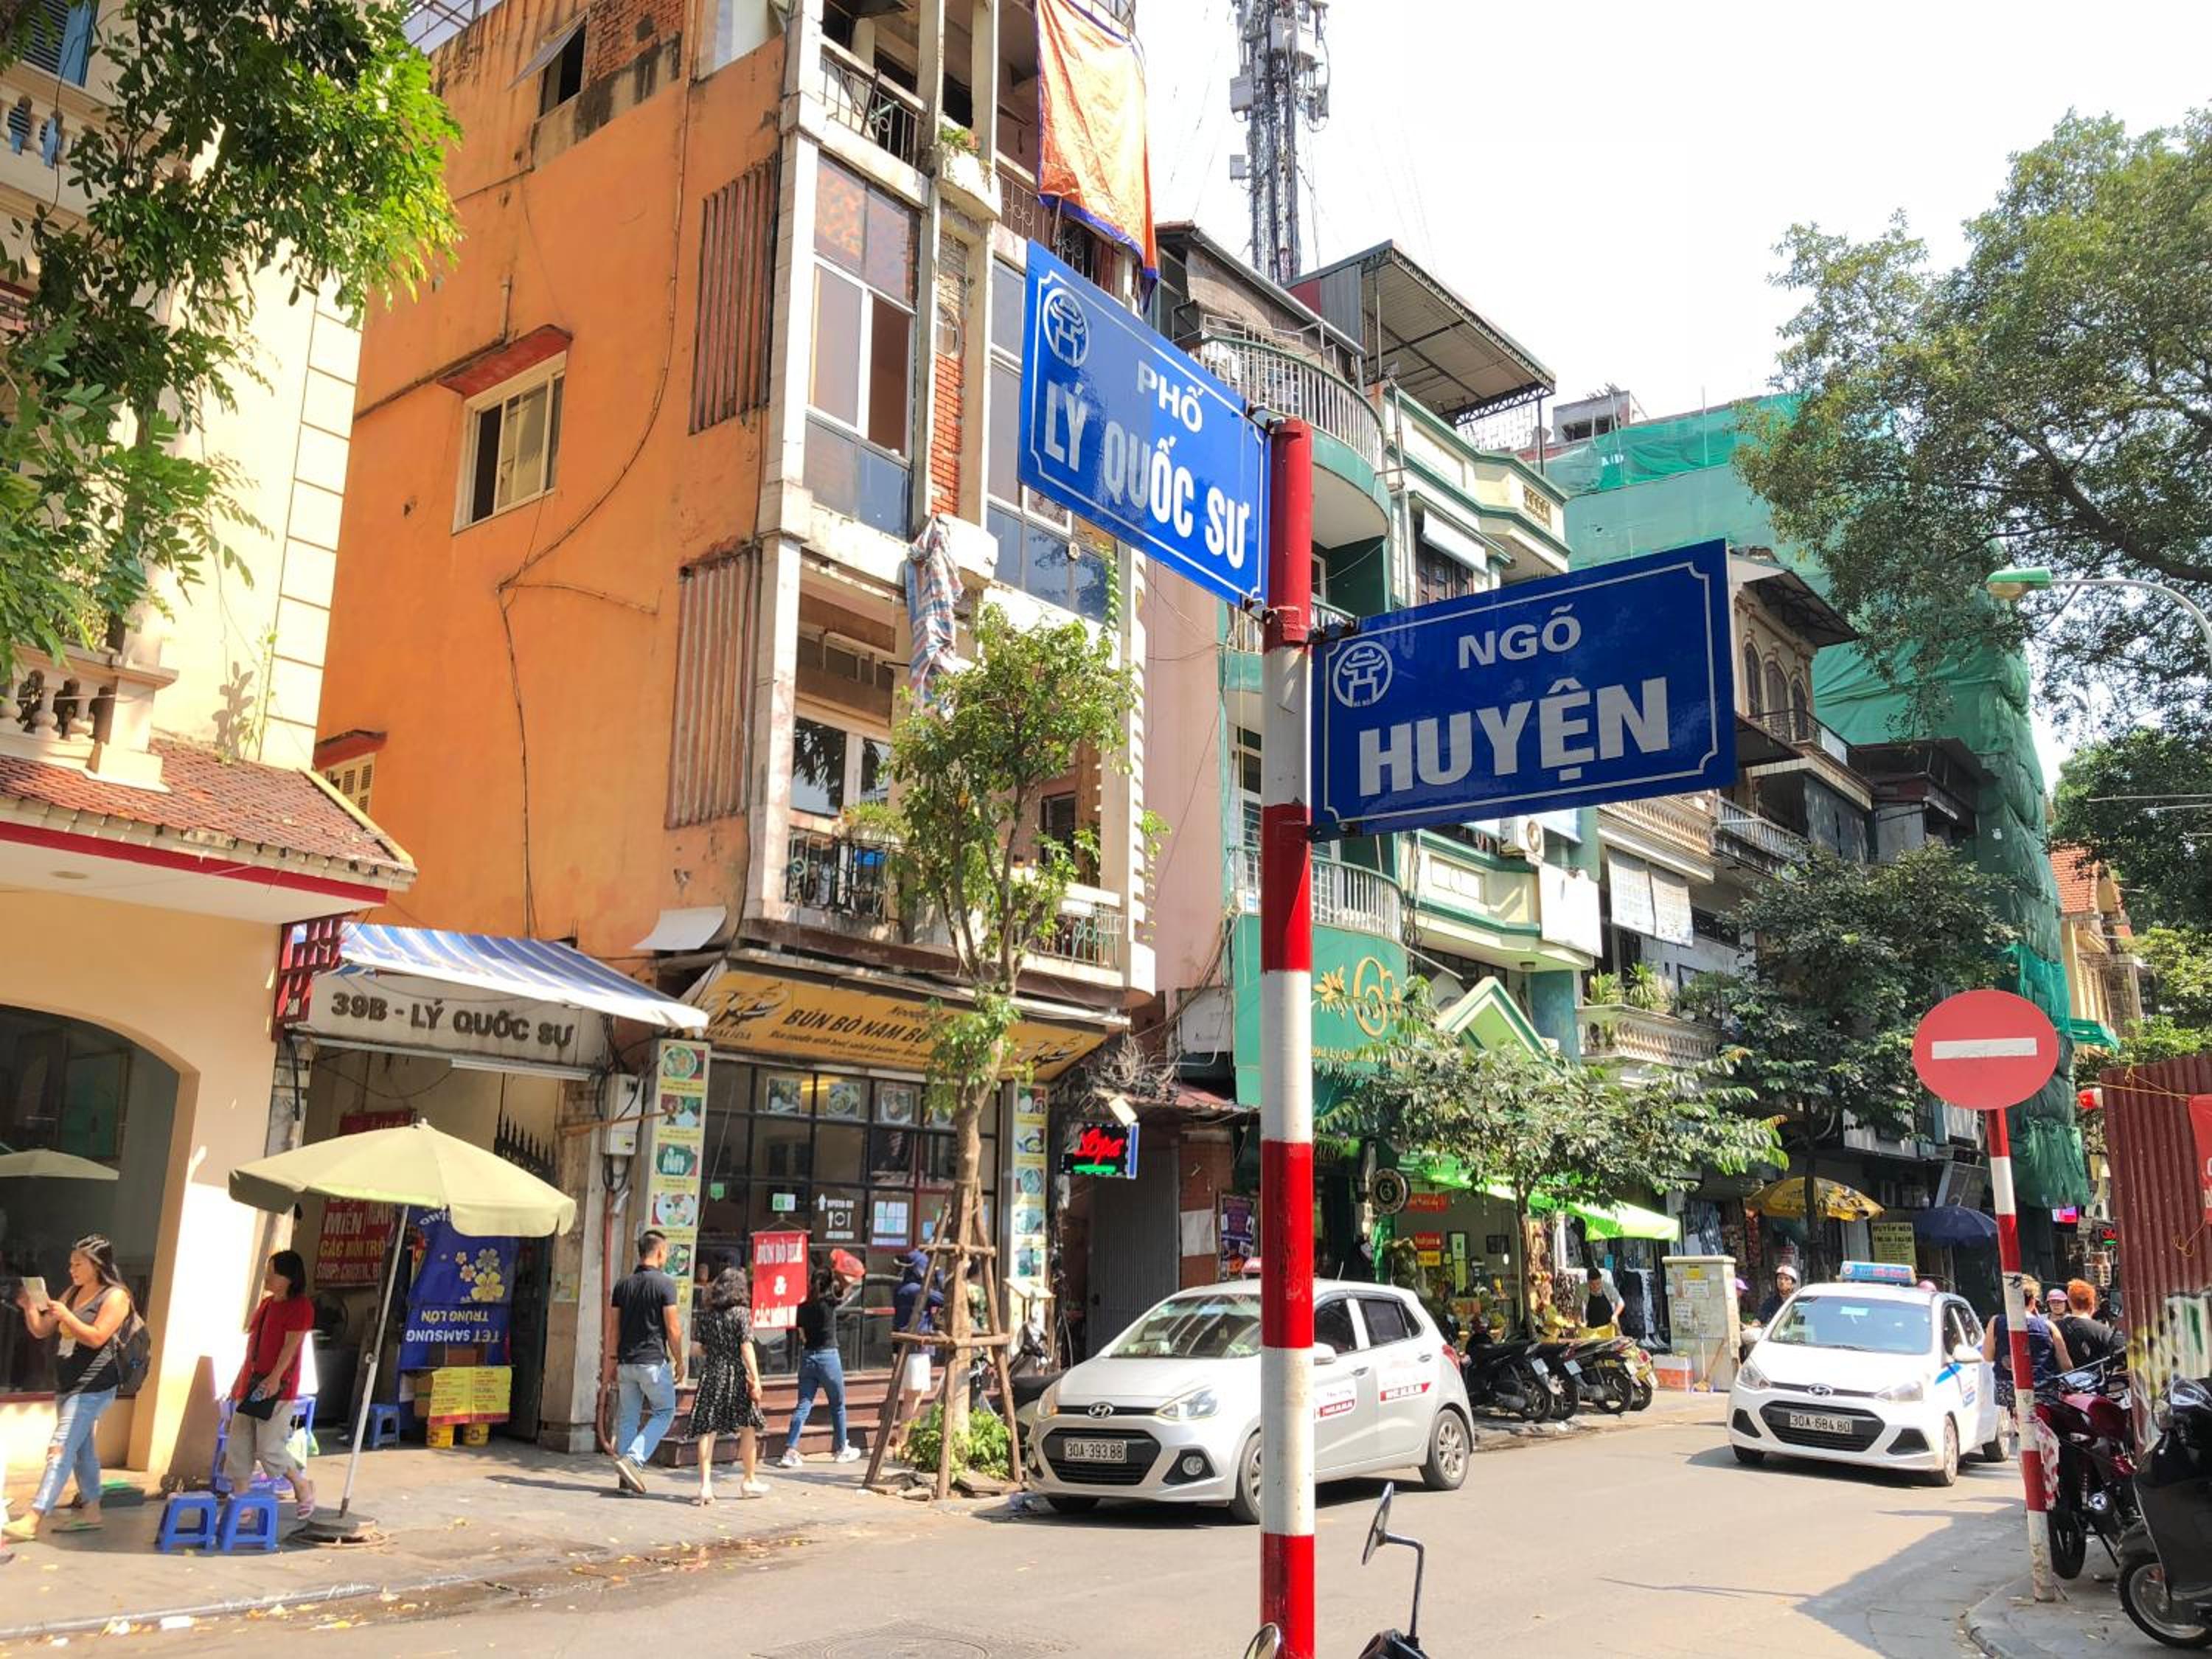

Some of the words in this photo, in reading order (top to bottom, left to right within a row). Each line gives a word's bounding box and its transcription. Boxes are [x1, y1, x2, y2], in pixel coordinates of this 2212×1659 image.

[1136, 359, 1205, 433] PHỐ
[1044, 381, 1088, 472] LÝ
[1104, 421, 1194, 538] QUỐC
[1205, 487, 1251, 570] SƯ
[1458, 602, 1582, 669] NGÕ
[1358, 676, 1670, 797] HUYỆN
[331, 992, 388, 1021] 39B
[411, 998, 444, 1030] LÝ
[855, 1020, 908, 1040] NAM
[773, 1275, 787, 1296] &
[405, 1329, 471, 1343] SAMSUNG
